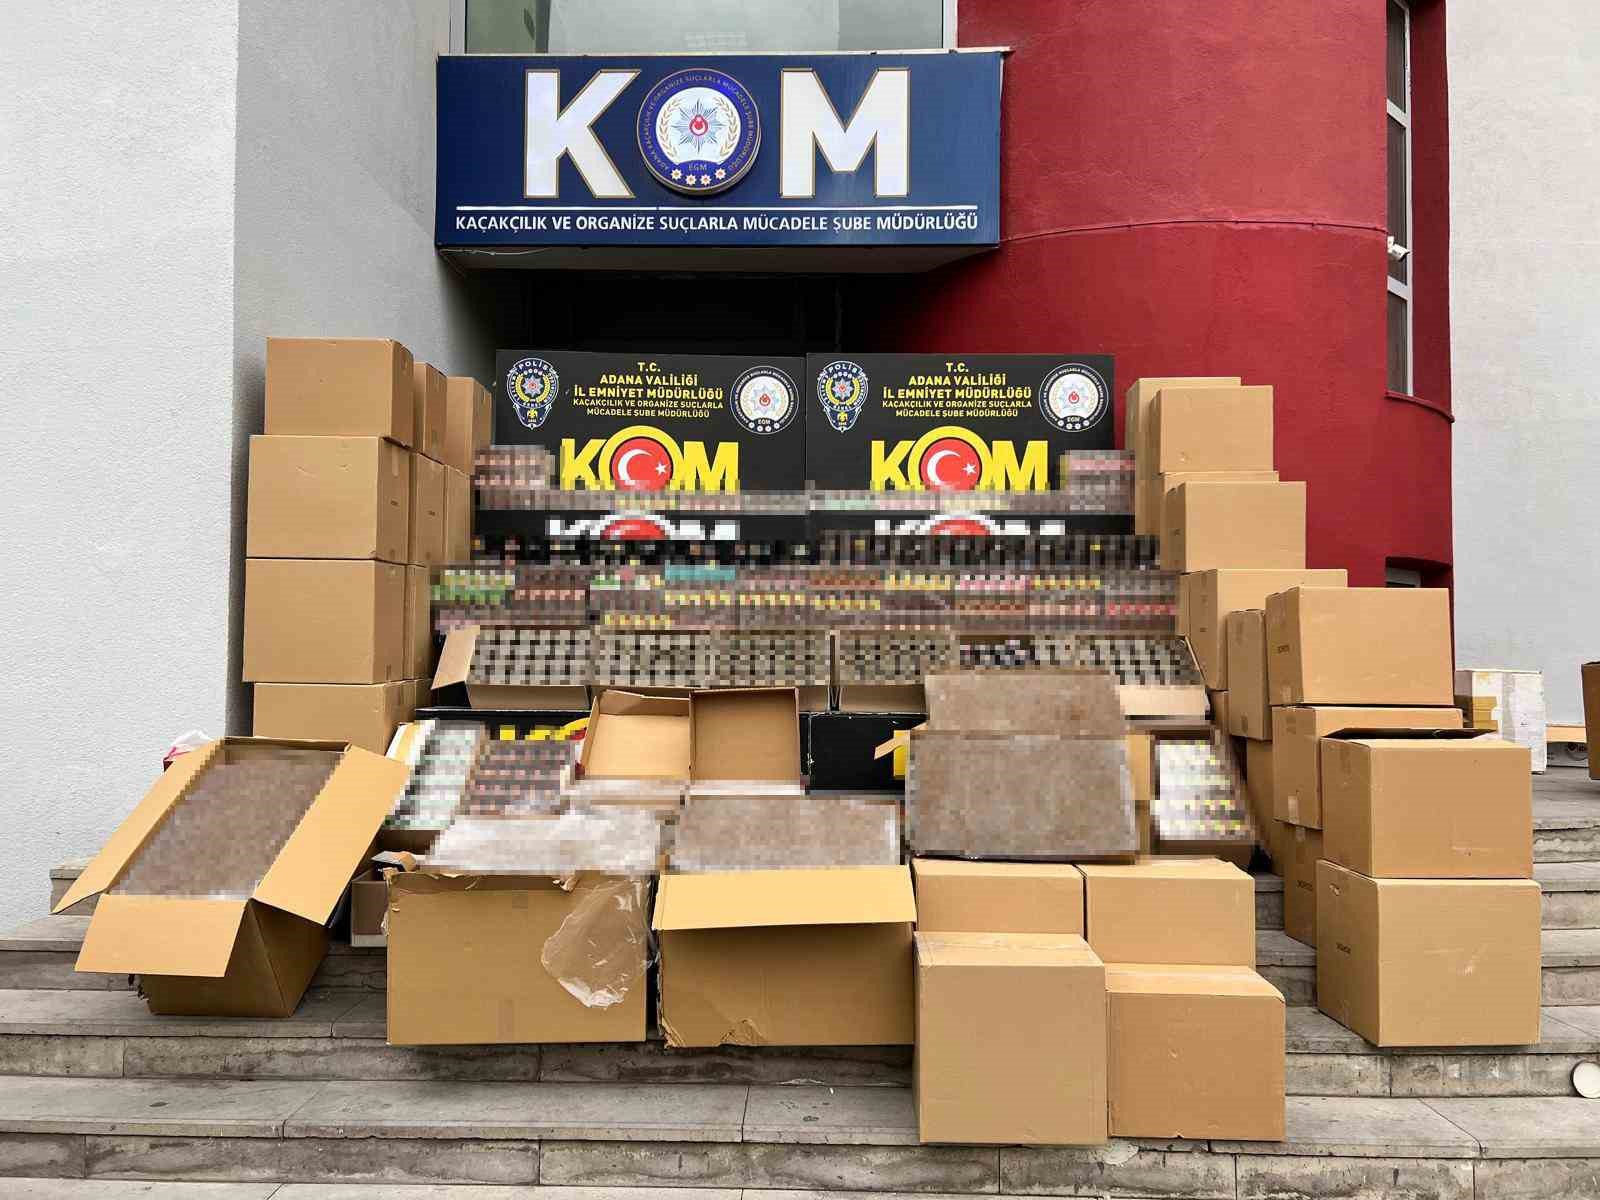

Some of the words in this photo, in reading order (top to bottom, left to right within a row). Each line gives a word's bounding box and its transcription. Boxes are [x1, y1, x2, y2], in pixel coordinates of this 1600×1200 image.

[456, 215, 547, 233] KAÇAKÇILIK
[552, 216, 571, 230] VE
[576, 214, 654, 230] ORGANİZE
[659, 216, 738, 233] SUÇLARLA
[743, 214, 827, 230] MÜCADELE
[833, 216, 871, 233] ŞUBE
[876, 212, 978, 230] MÜDÜRLÜĞÜ
[637, 361, 661, 372] T.C.
[946, 362, 969, 372] T.C.
[600, 374, 642, 385] ADANA
[646, 373, 698, 386] VALİLİĞİ
[909, 375, 951, 385] ADANA
[954, 373, 1006, 386] VALİLİĞİ
[575, 385, 586, 397] İL
[588, 385, 643, 398] EMNİYET
[647, 386, 723, 399] MÜDÜRLÜĞÜ
[883, 386, 895, 399] İL
[898, 386, 952, 399] EMNİYET
[955, 386, 1032, 399] MÜDÜRLÜĞÜ
[637, 399, 678, 408] ORGANİZE
[882, 400, 932, 409] KAÇAKÇILIK
[934, 400, 944, 408] VE
[946, 399, 987, 408] ORGANİZE
[587, 408, 631, 416] MÜCADELE
[658, 409, 709, 418] MÜDÜRLÜĞÜ
[896, 408, 939, 417] MÜCADELE
[942, 409, 964, 418] ŞUBE
[966, 408, 1018, 417] MÜDÜRLÜĞÜ
[560, 425, 740, 492] KOM
[870, 425, 1049, 491] KOM
